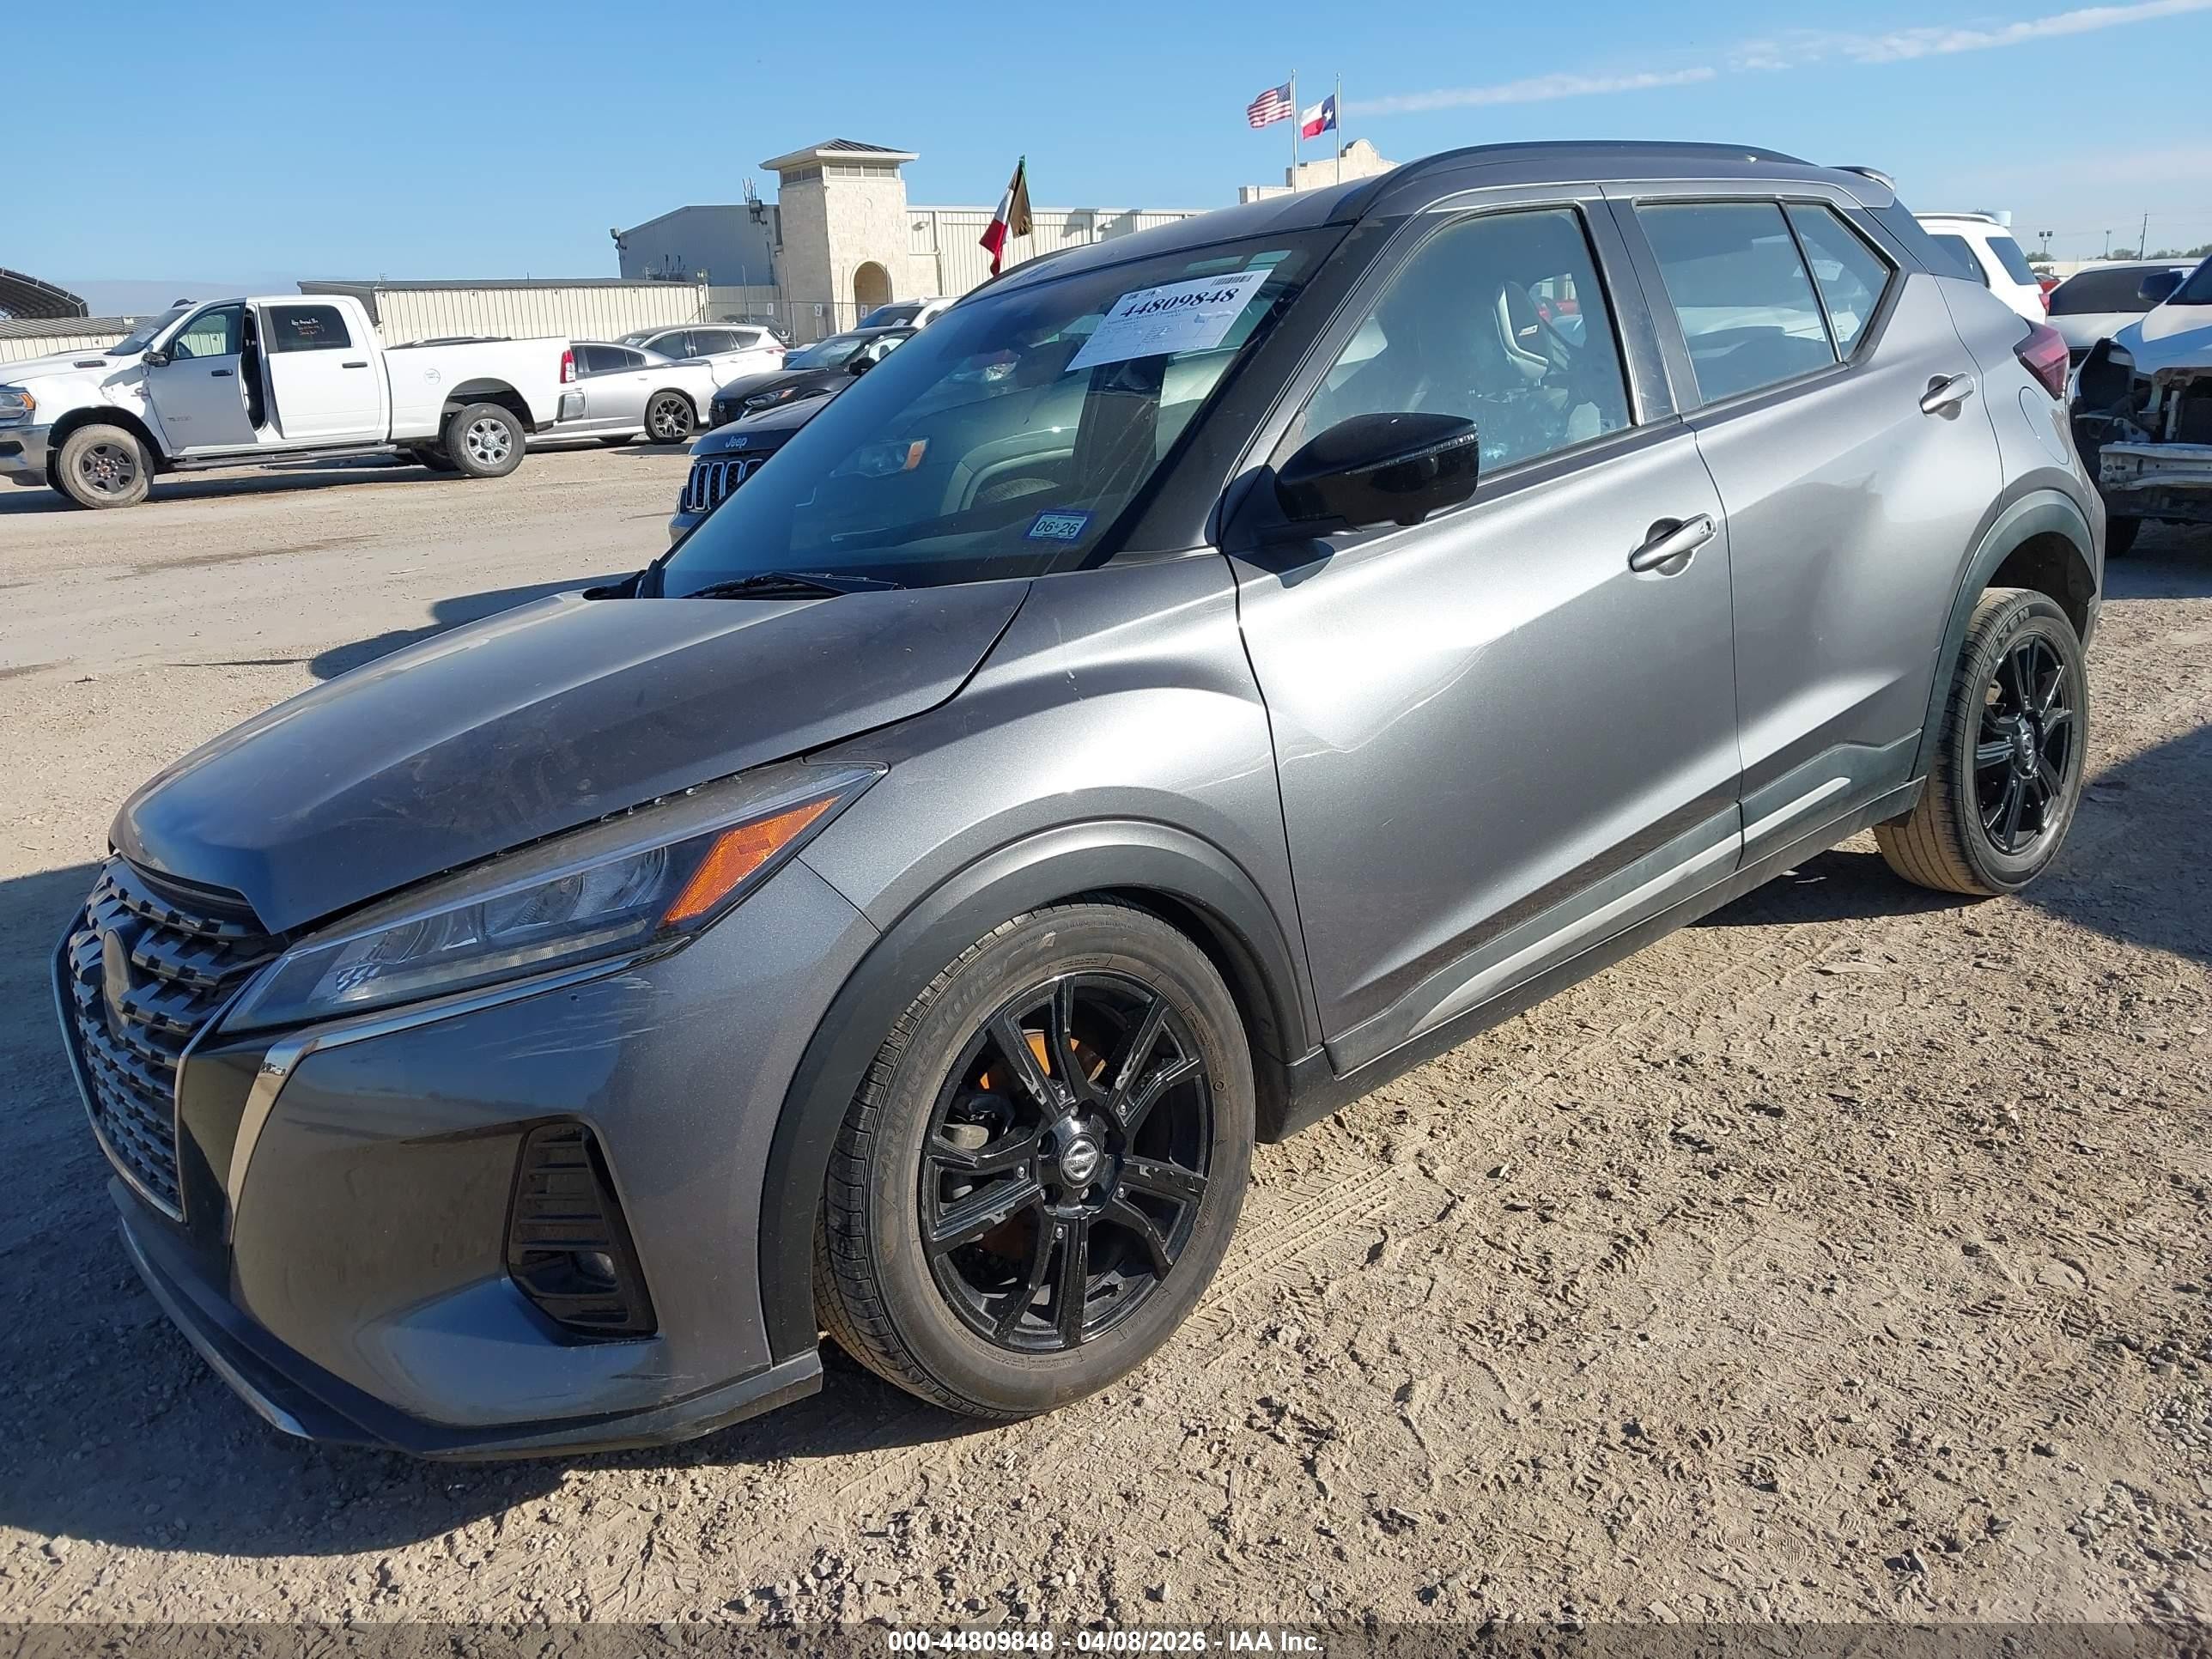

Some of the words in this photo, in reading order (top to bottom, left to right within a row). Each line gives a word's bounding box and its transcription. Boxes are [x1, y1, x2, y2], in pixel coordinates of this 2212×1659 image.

[1121, 288, 1239, 318] 44809848
[725, 435, 748, 449] Jeep
[1036, 520, 1055, 532] 06
[1058, 522, 1079, 534] 26
[1981, 607, 2030, 680] NEXEN
